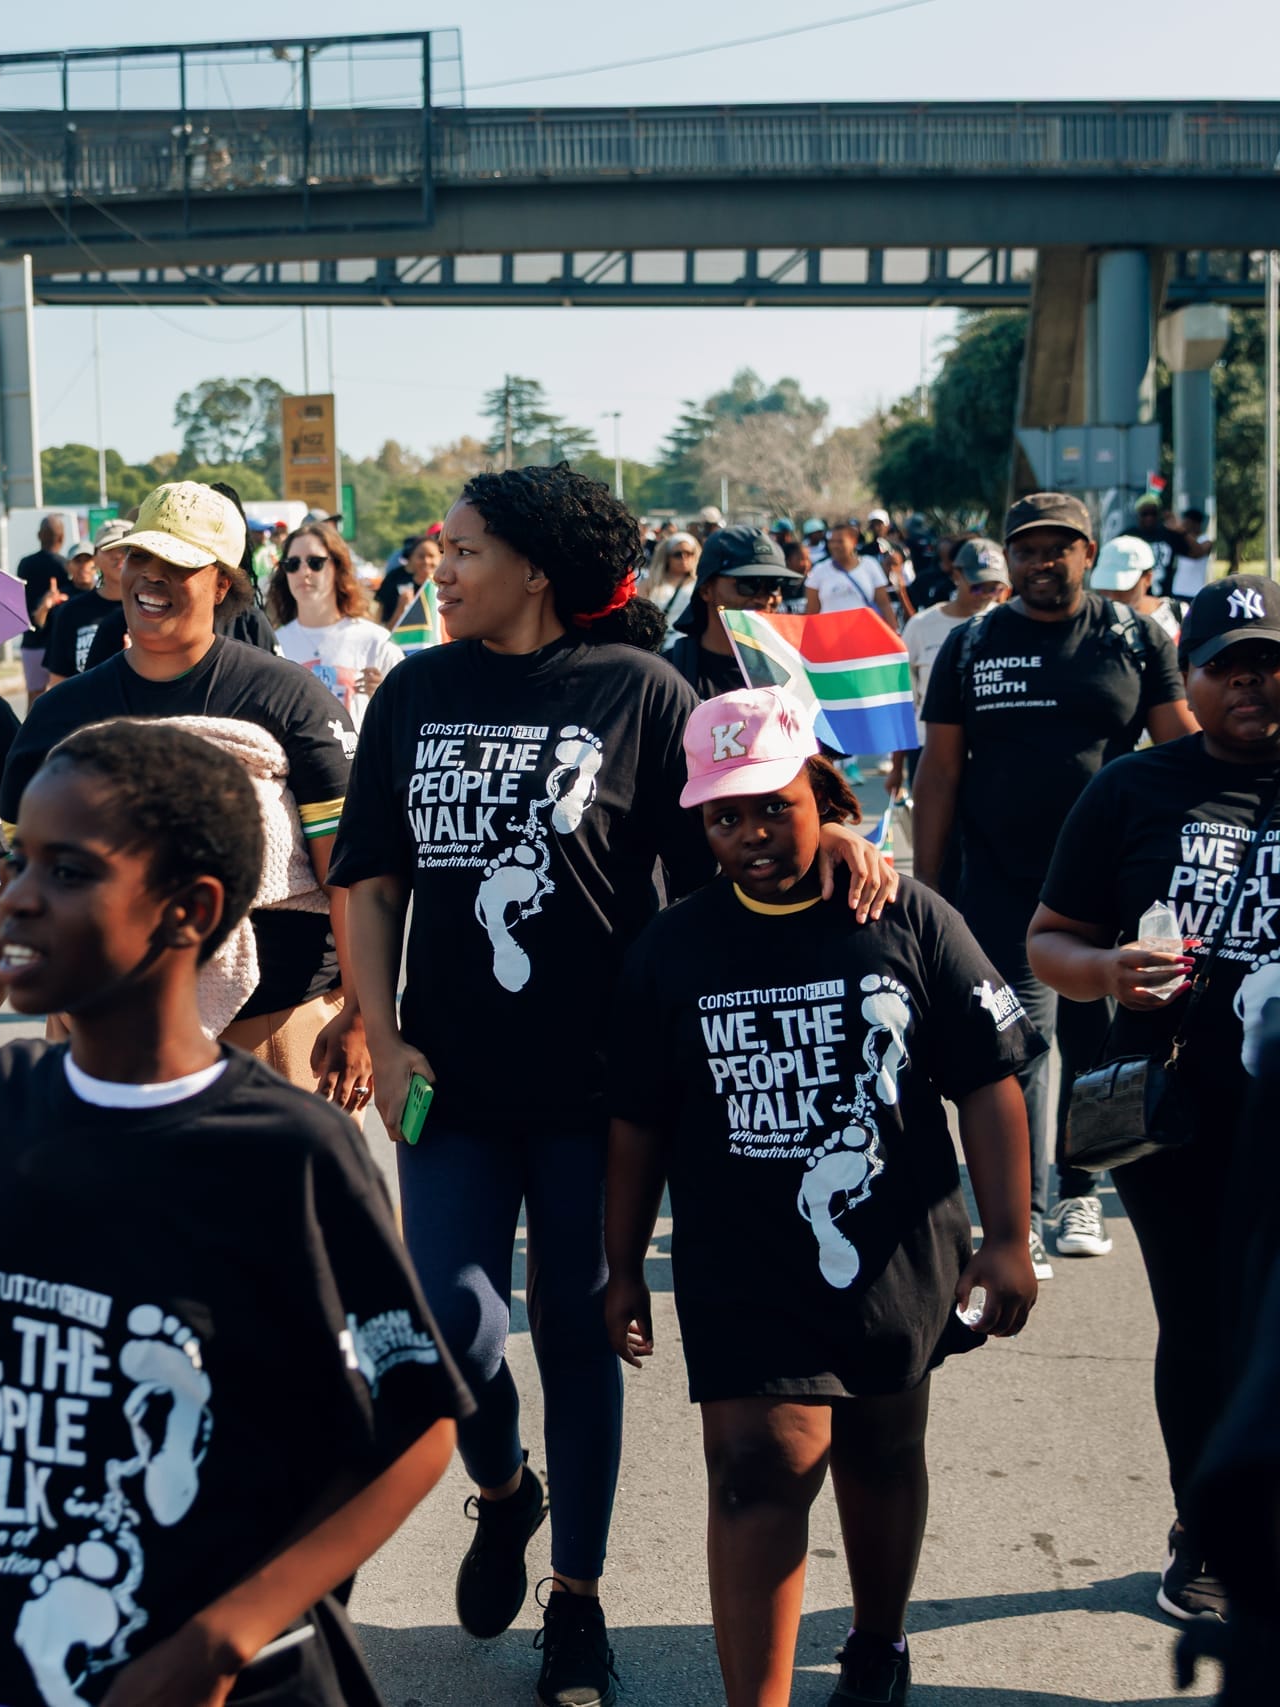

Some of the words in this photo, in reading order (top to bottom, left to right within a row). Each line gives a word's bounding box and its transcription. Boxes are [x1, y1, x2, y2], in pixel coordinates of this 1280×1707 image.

[973, 656, 1042, 673] HANDLE
[973, 670, 1004, 685] THE
[973, 681, 1027, 697] TRUTH
[415, 739, 465, 771] WE,
[479, 742, 541, 771] THE
[711, 720, 747, 763] K
[408, 770, 521, 807] PEOPLE
[408, 806, 499, 842] WALK
[470, 842, 485, 853] of
[1181, 836, 1240, 877] WE,
[1168, 865, 1280, 907] PEOPL
[1243, 938, 1259, 949] of
[700, 1011, 768, 1054] WE,
[773, 1004, 846, 1048] THE
[707, 1046, 840, 1094] PEOPLE
[726, 1089, 824, 1131] WALK
[729, 1130, 790, 1143] Affirmation
[793, 1129, 808, 1142] of
[743, 1146, 811, 1158] Constitution
[12, 1315, 113, 1398] THE
